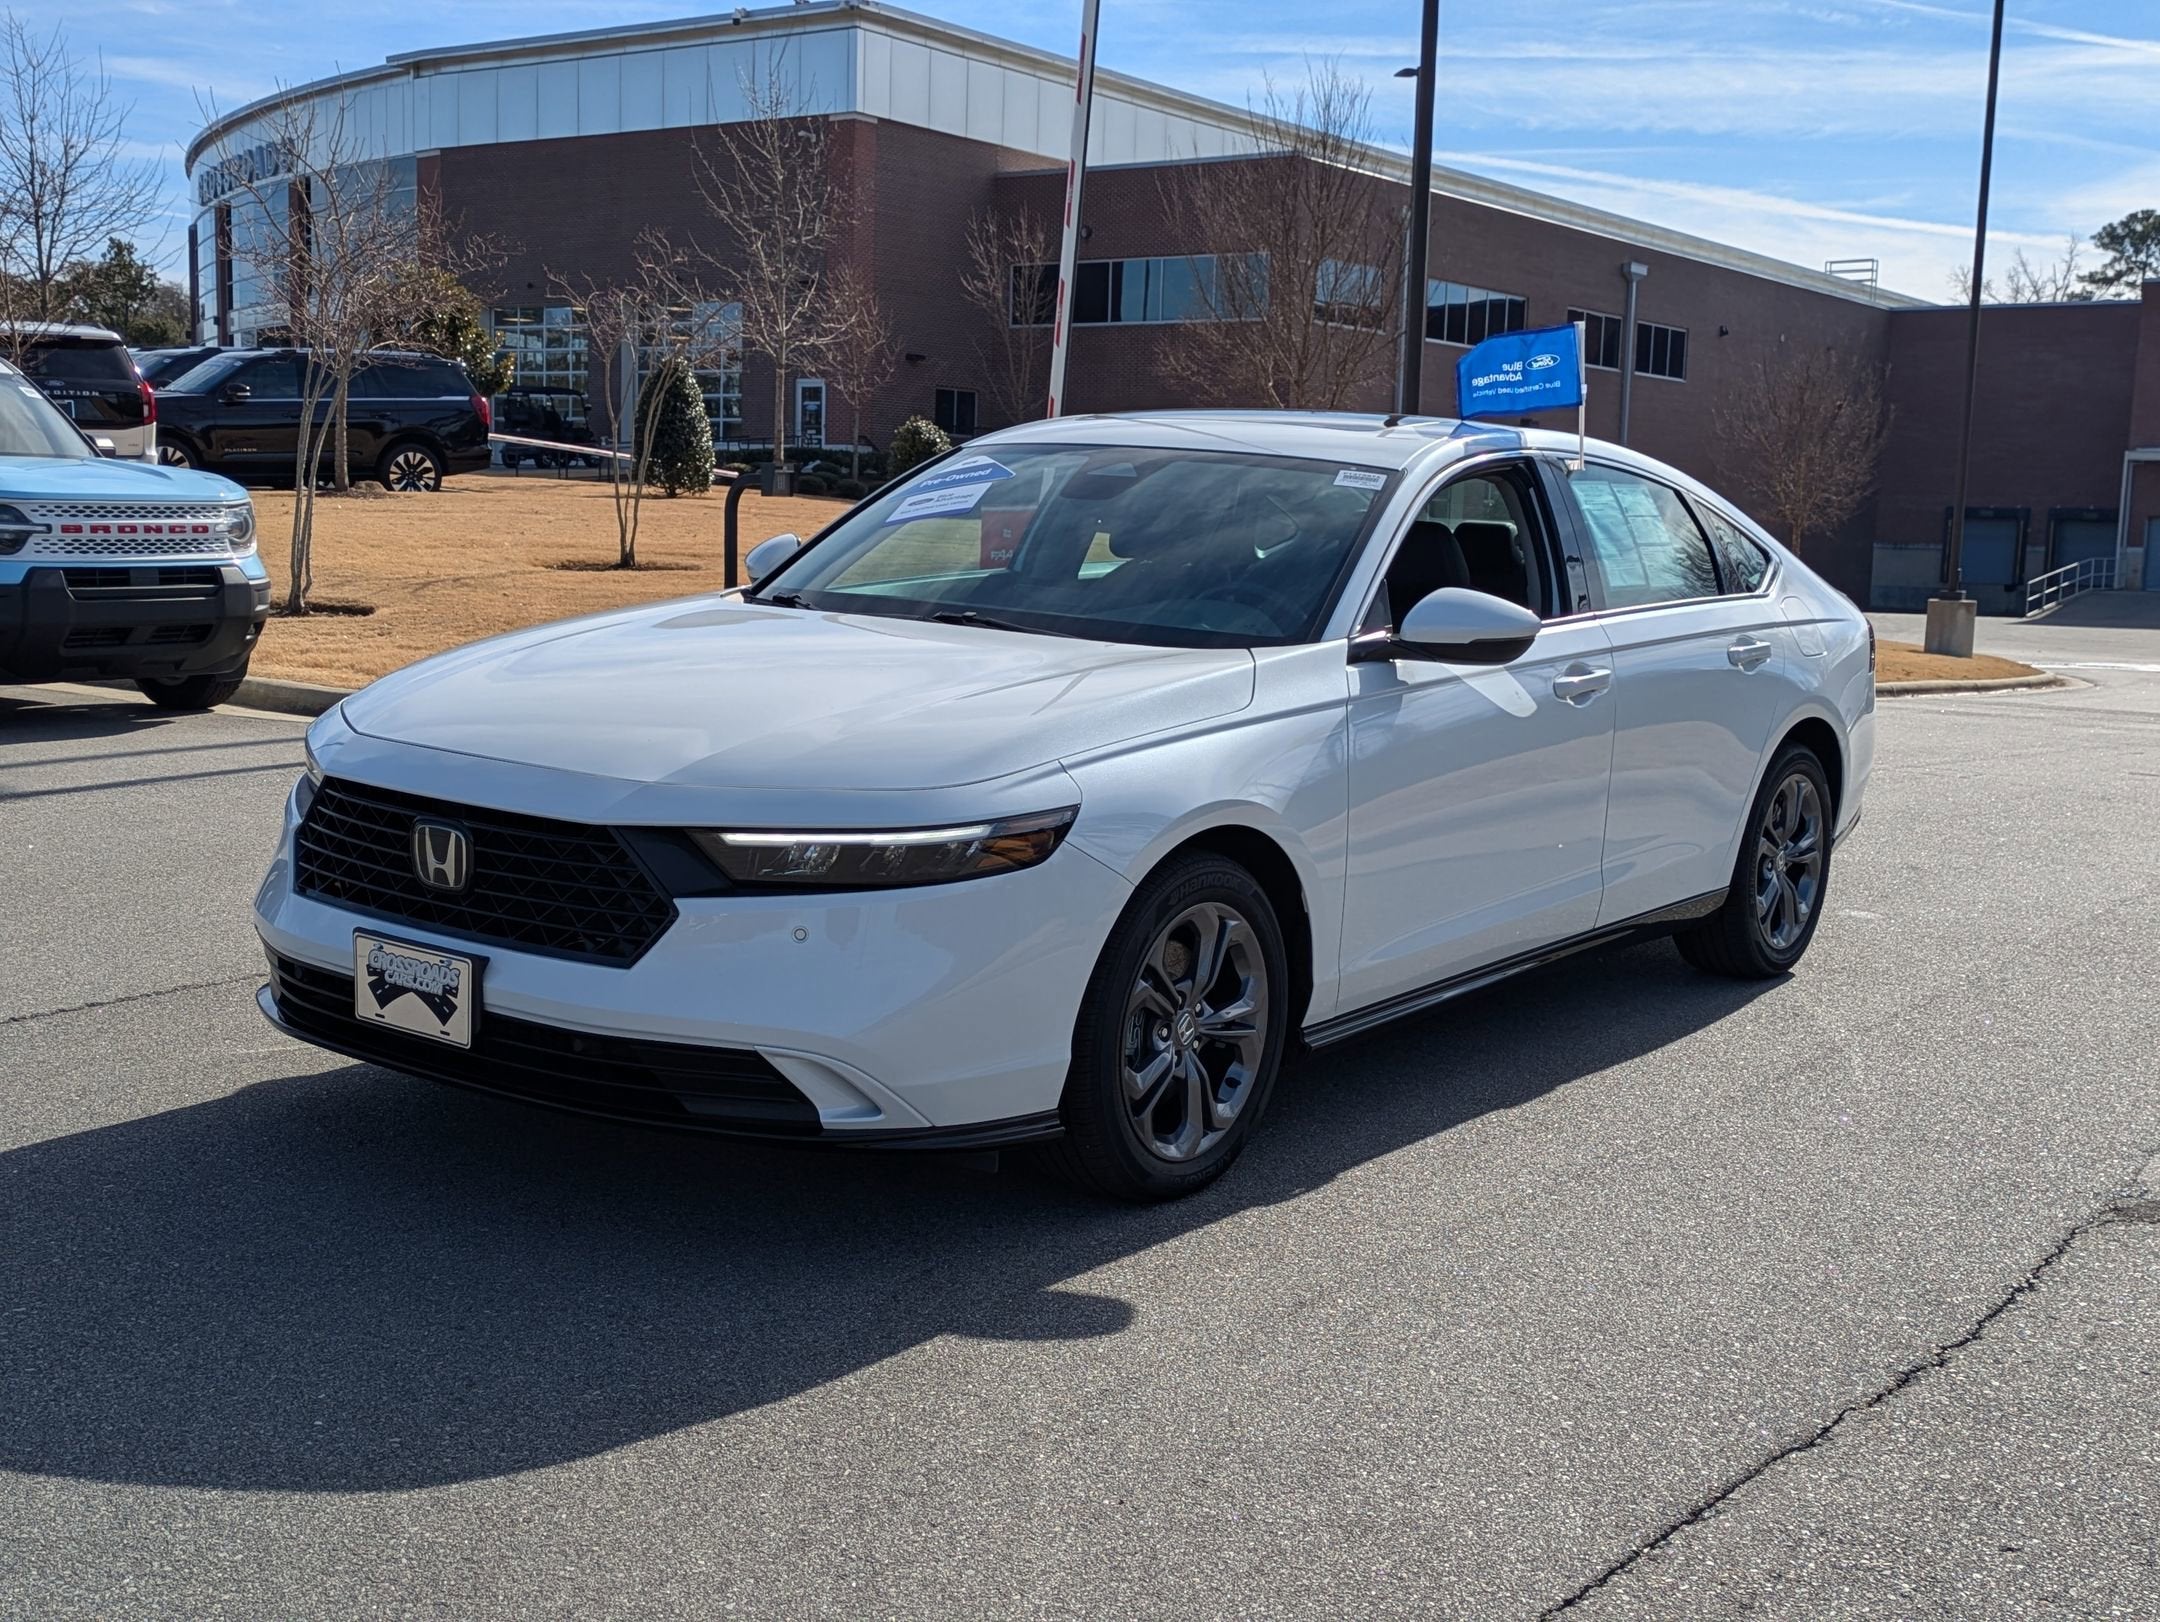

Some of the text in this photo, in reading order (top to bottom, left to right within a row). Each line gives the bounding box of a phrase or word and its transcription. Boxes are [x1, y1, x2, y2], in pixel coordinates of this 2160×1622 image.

[920, 468, 992, 488] Pre-Owned
[61, 524, 209, 534] BRONCO
[368, 949, 460, 988] CROSSROADS
[384, 970, 443, 996] CARS.COM
